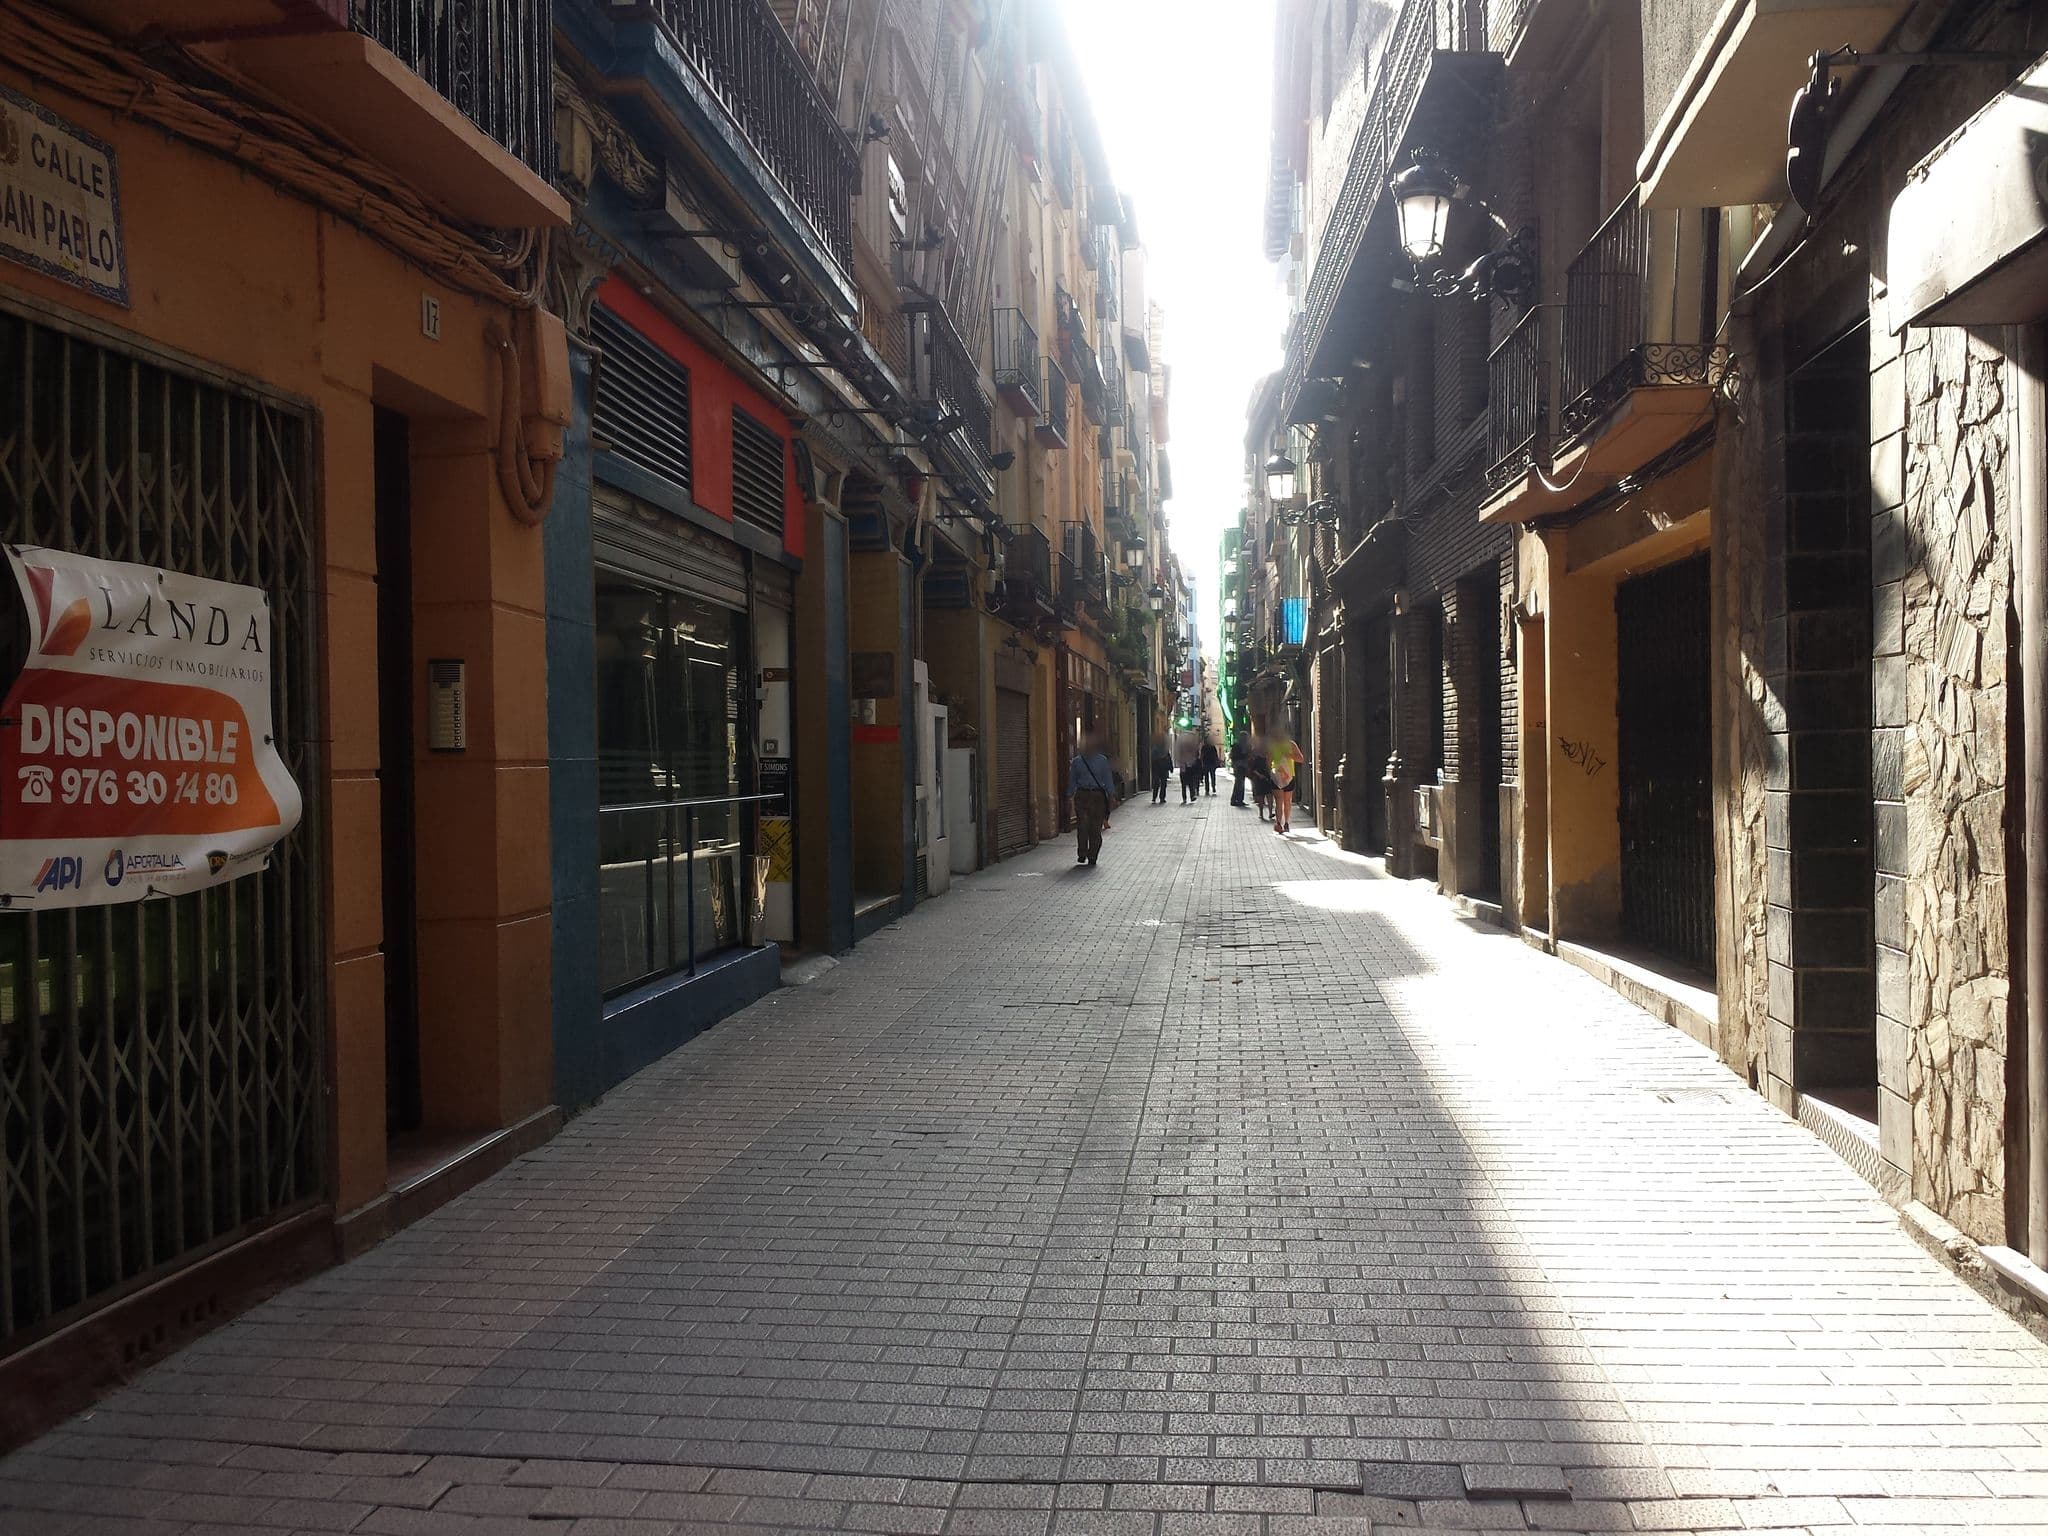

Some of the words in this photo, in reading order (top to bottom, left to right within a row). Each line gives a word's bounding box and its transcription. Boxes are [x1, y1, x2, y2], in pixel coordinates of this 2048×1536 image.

[32, 133, 104, 198] CALLE
[0, 185, 36, 239] AN
[43, 201, 114, 272] PABLO
[427, 300, 438, 334] 17
[99, 587, 263, 653] LANDA
[90, 648, 164, 670] SERVICIOS
[170, 660, 264, 683] INMOBILIARIOS
[20, 704, 239, 763] DISPONIBLE
[61, 768, 118, 804] 976
[127, 770, 167, 804] 30
[175, 772, 200, 804] 14
[205, 773, 238, 804] 80
[37, 856, 82, 892] API
[126, 854, 184, 869] APORTALIA
